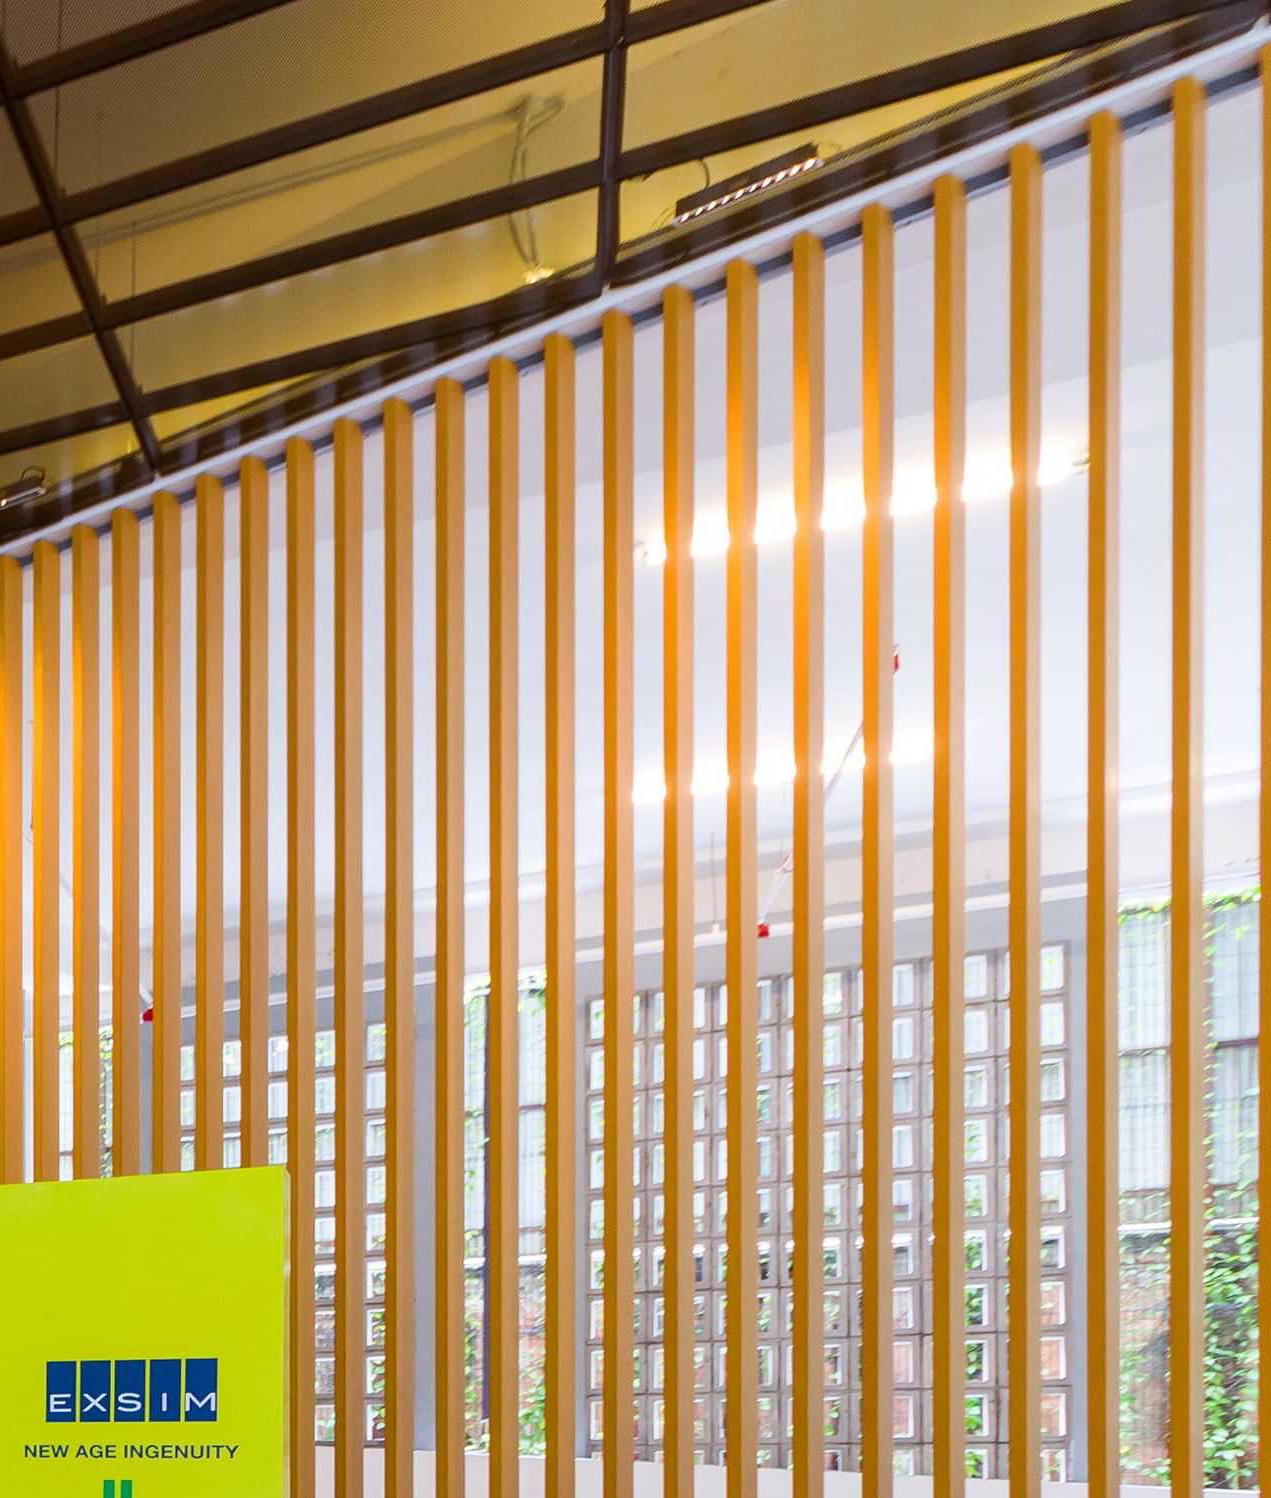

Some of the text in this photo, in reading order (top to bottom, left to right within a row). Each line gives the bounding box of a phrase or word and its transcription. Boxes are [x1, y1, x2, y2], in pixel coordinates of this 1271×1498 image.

[49, 1391, 217, 1413] EXSIM
[24, 1443, 240, 1460] NEW AGE INGENUITY
